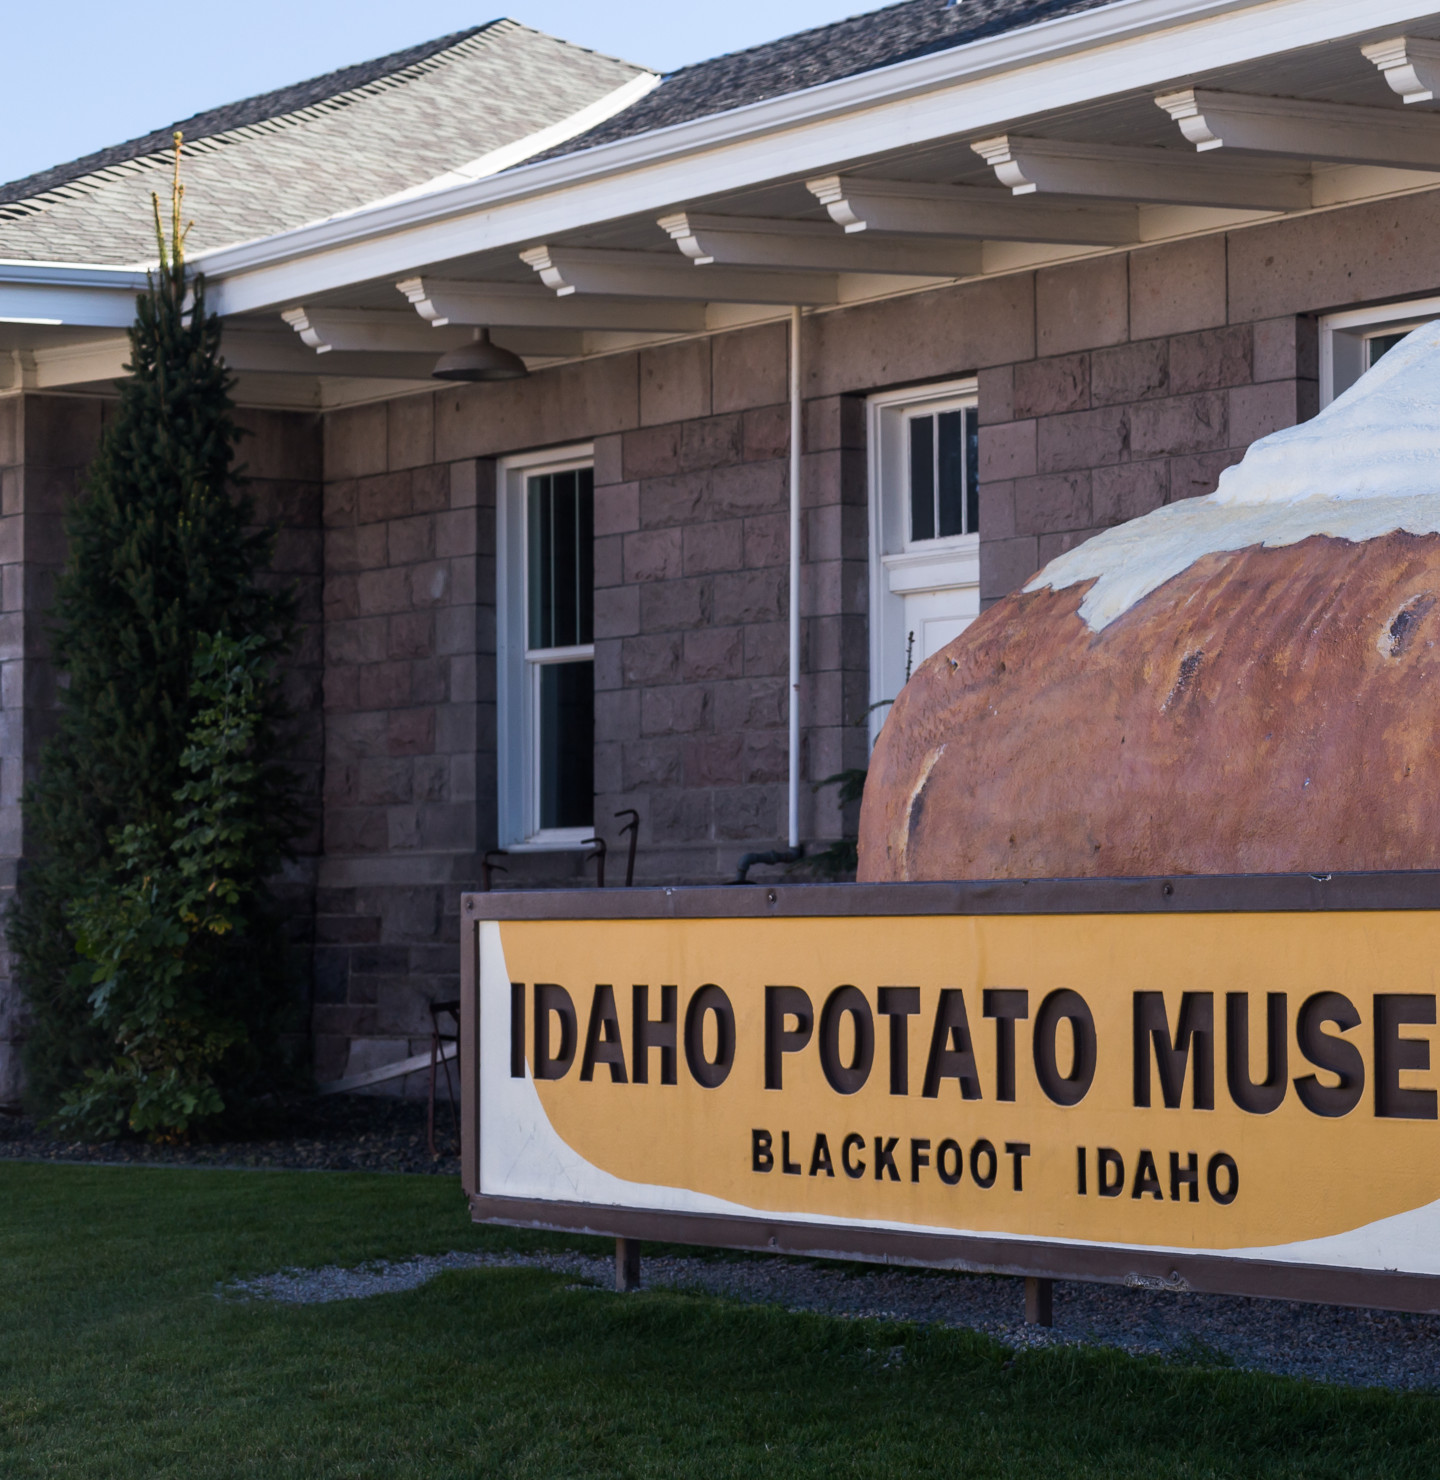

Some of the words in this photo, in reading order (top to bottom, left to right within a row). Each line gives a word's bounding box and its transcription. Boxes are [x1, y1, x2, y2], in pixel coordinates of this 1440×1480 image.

[510, 982, 737, 1089] IDAHO
[764, 985, 1098, 1107] POTATO
[751, 1128, 1031, 1192] BLACKFOOT
[1076, 1146, 1240, 1206] IDAHO
